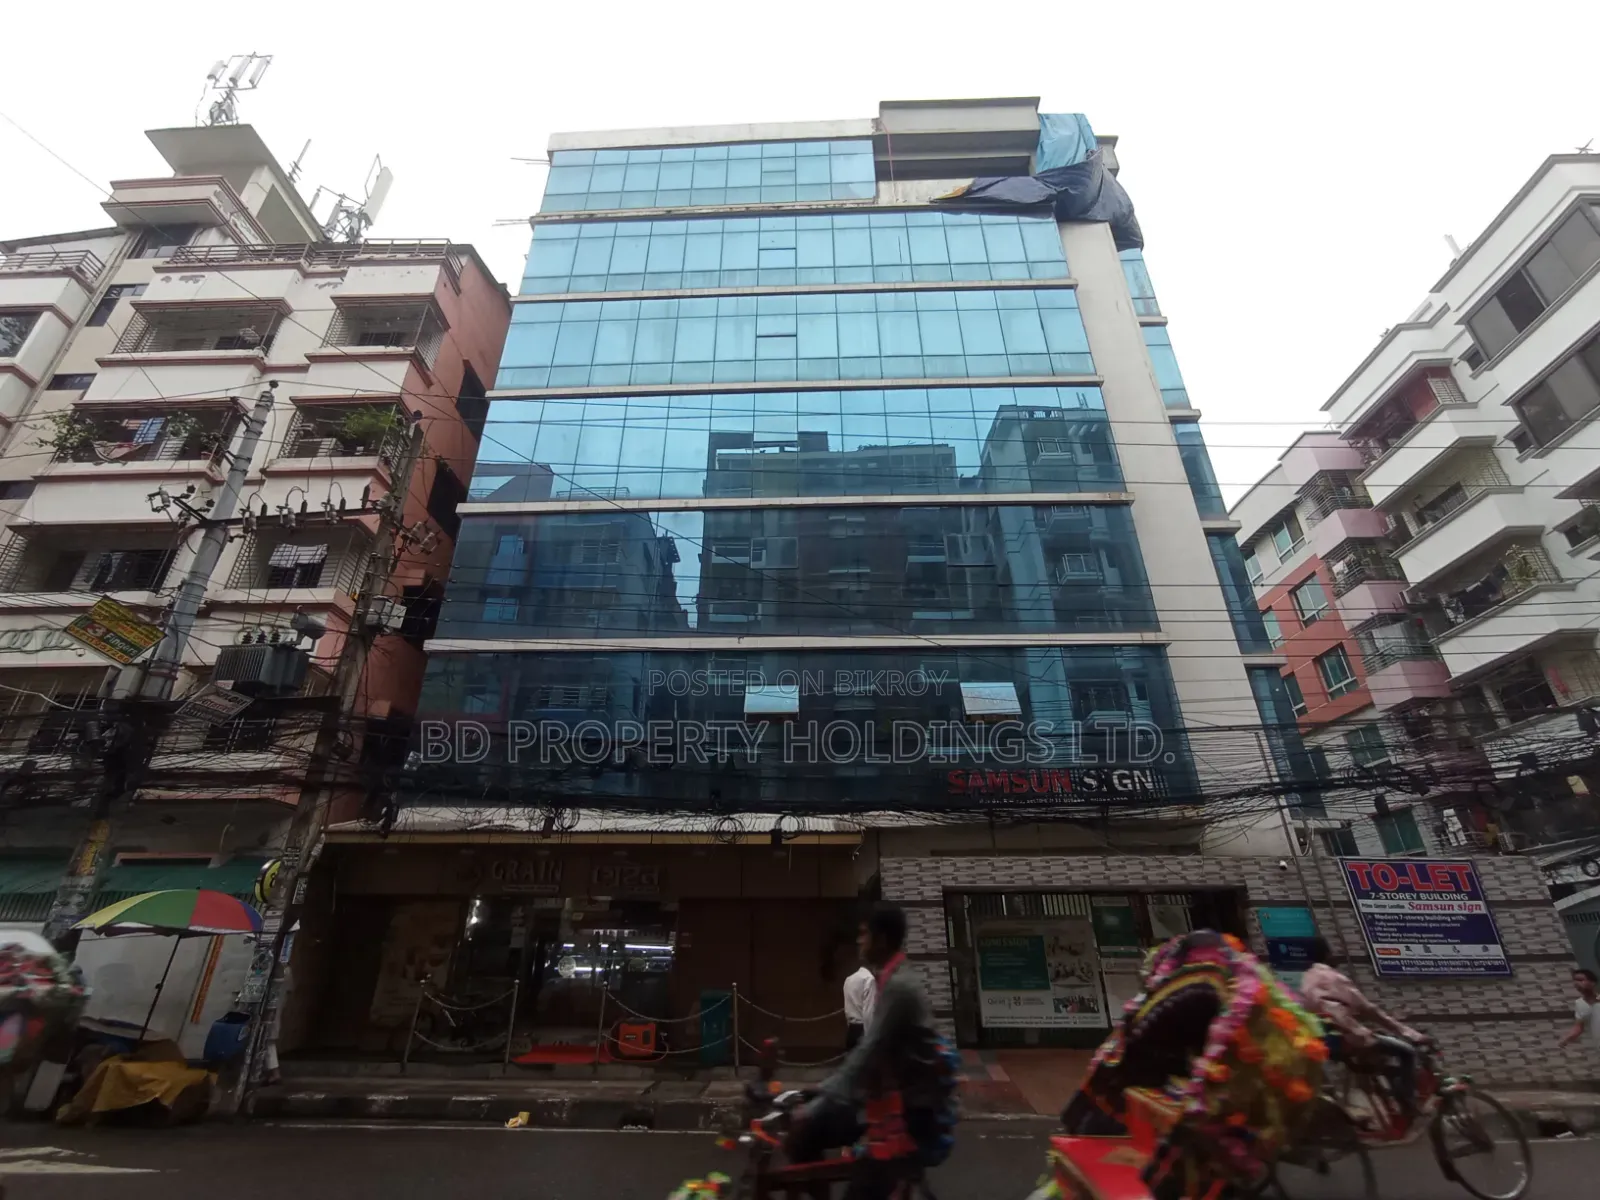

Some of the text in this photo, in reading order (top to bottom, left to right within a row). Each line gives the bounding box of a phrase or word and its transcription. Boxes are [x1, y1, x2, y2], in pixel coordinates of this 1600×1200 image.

[104, 632, 138, 656] Fingers
[948, 768, 1072, 793] SAMSUN
[492, 859, 562, 884] GRAIN
[1346, 863, 1472, 892] TO-LET
[1369, 892, 1469, 901] 7-STOREY BUILDING
[1408, 901, 1455, 911] Samsun
[1457, 902, 1482, 913] sign
